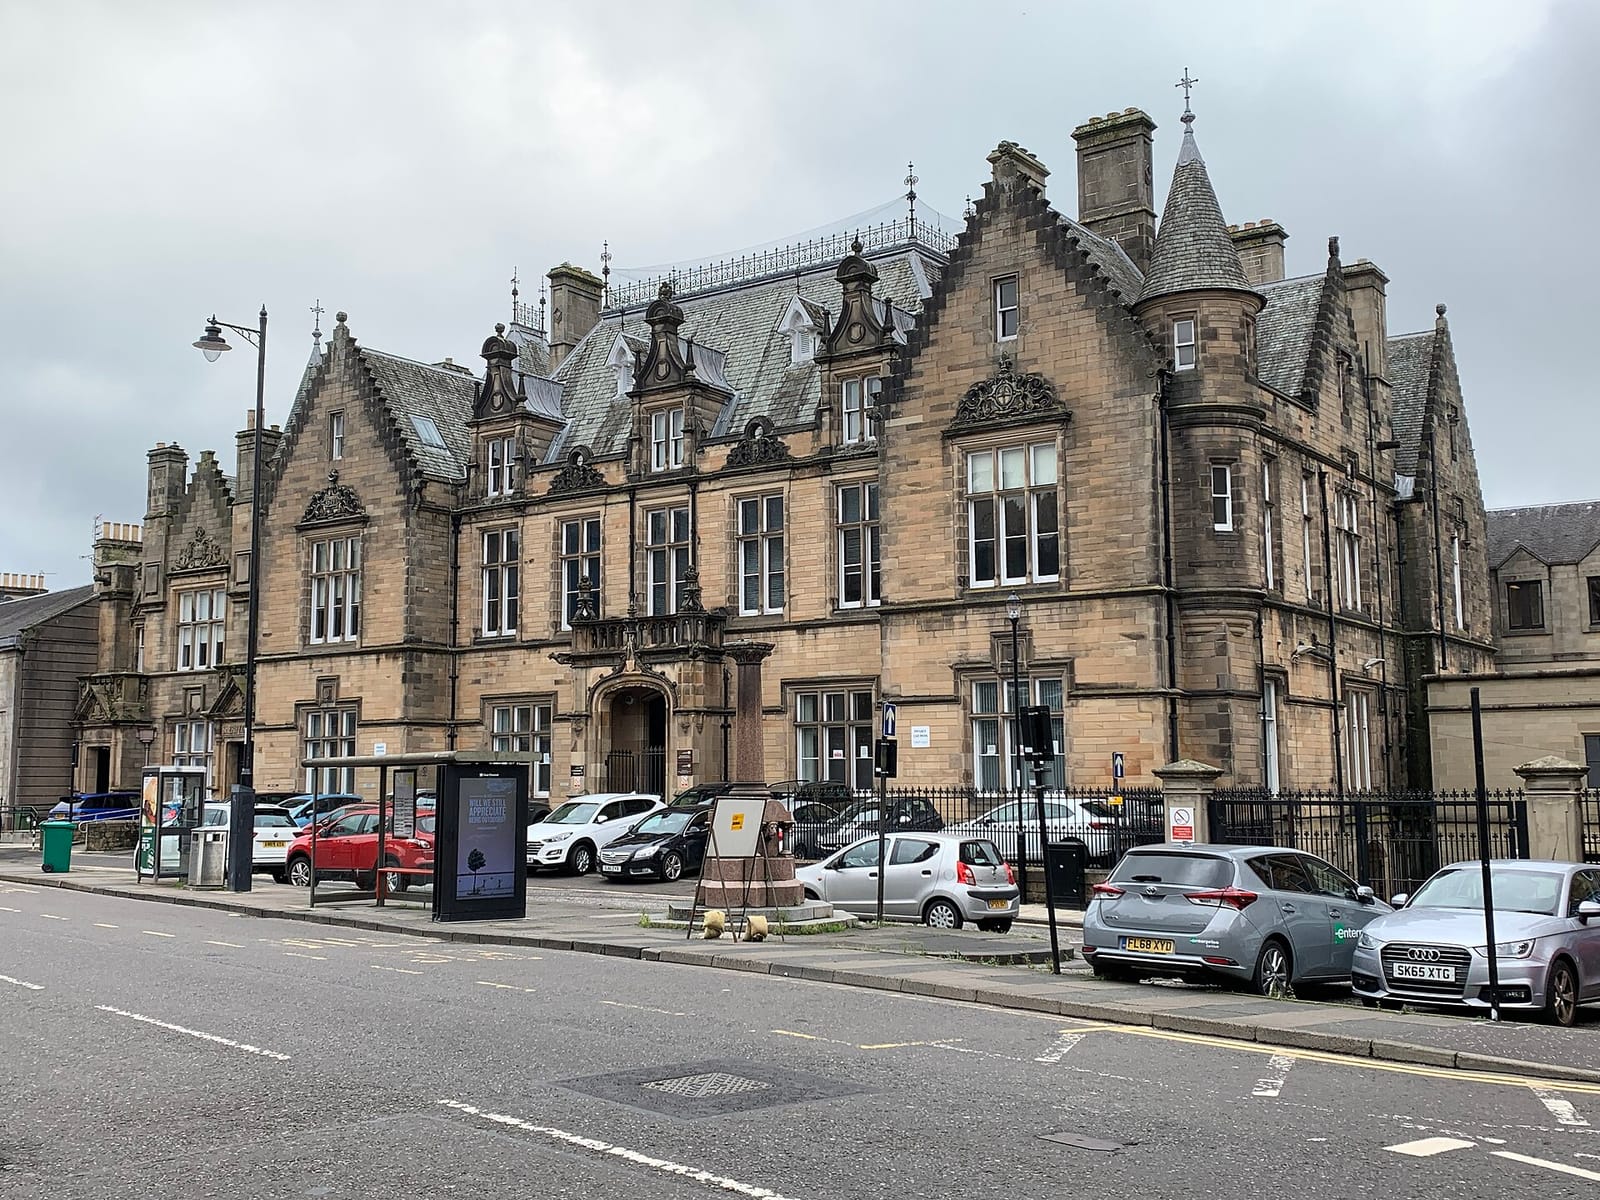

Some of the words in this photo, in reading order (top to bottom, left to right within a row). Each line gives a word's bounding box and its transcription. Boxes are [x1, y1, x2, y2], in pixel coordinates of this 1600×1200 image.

[469, 806, 506, 816] APPRECIATE
[1127, 938, 1152, 950] FL68
[1153, 940, 1172, 951] XYD
[1397, 965, 1425, 977] SK65
[1428, 967, 1450, 979] XTG
